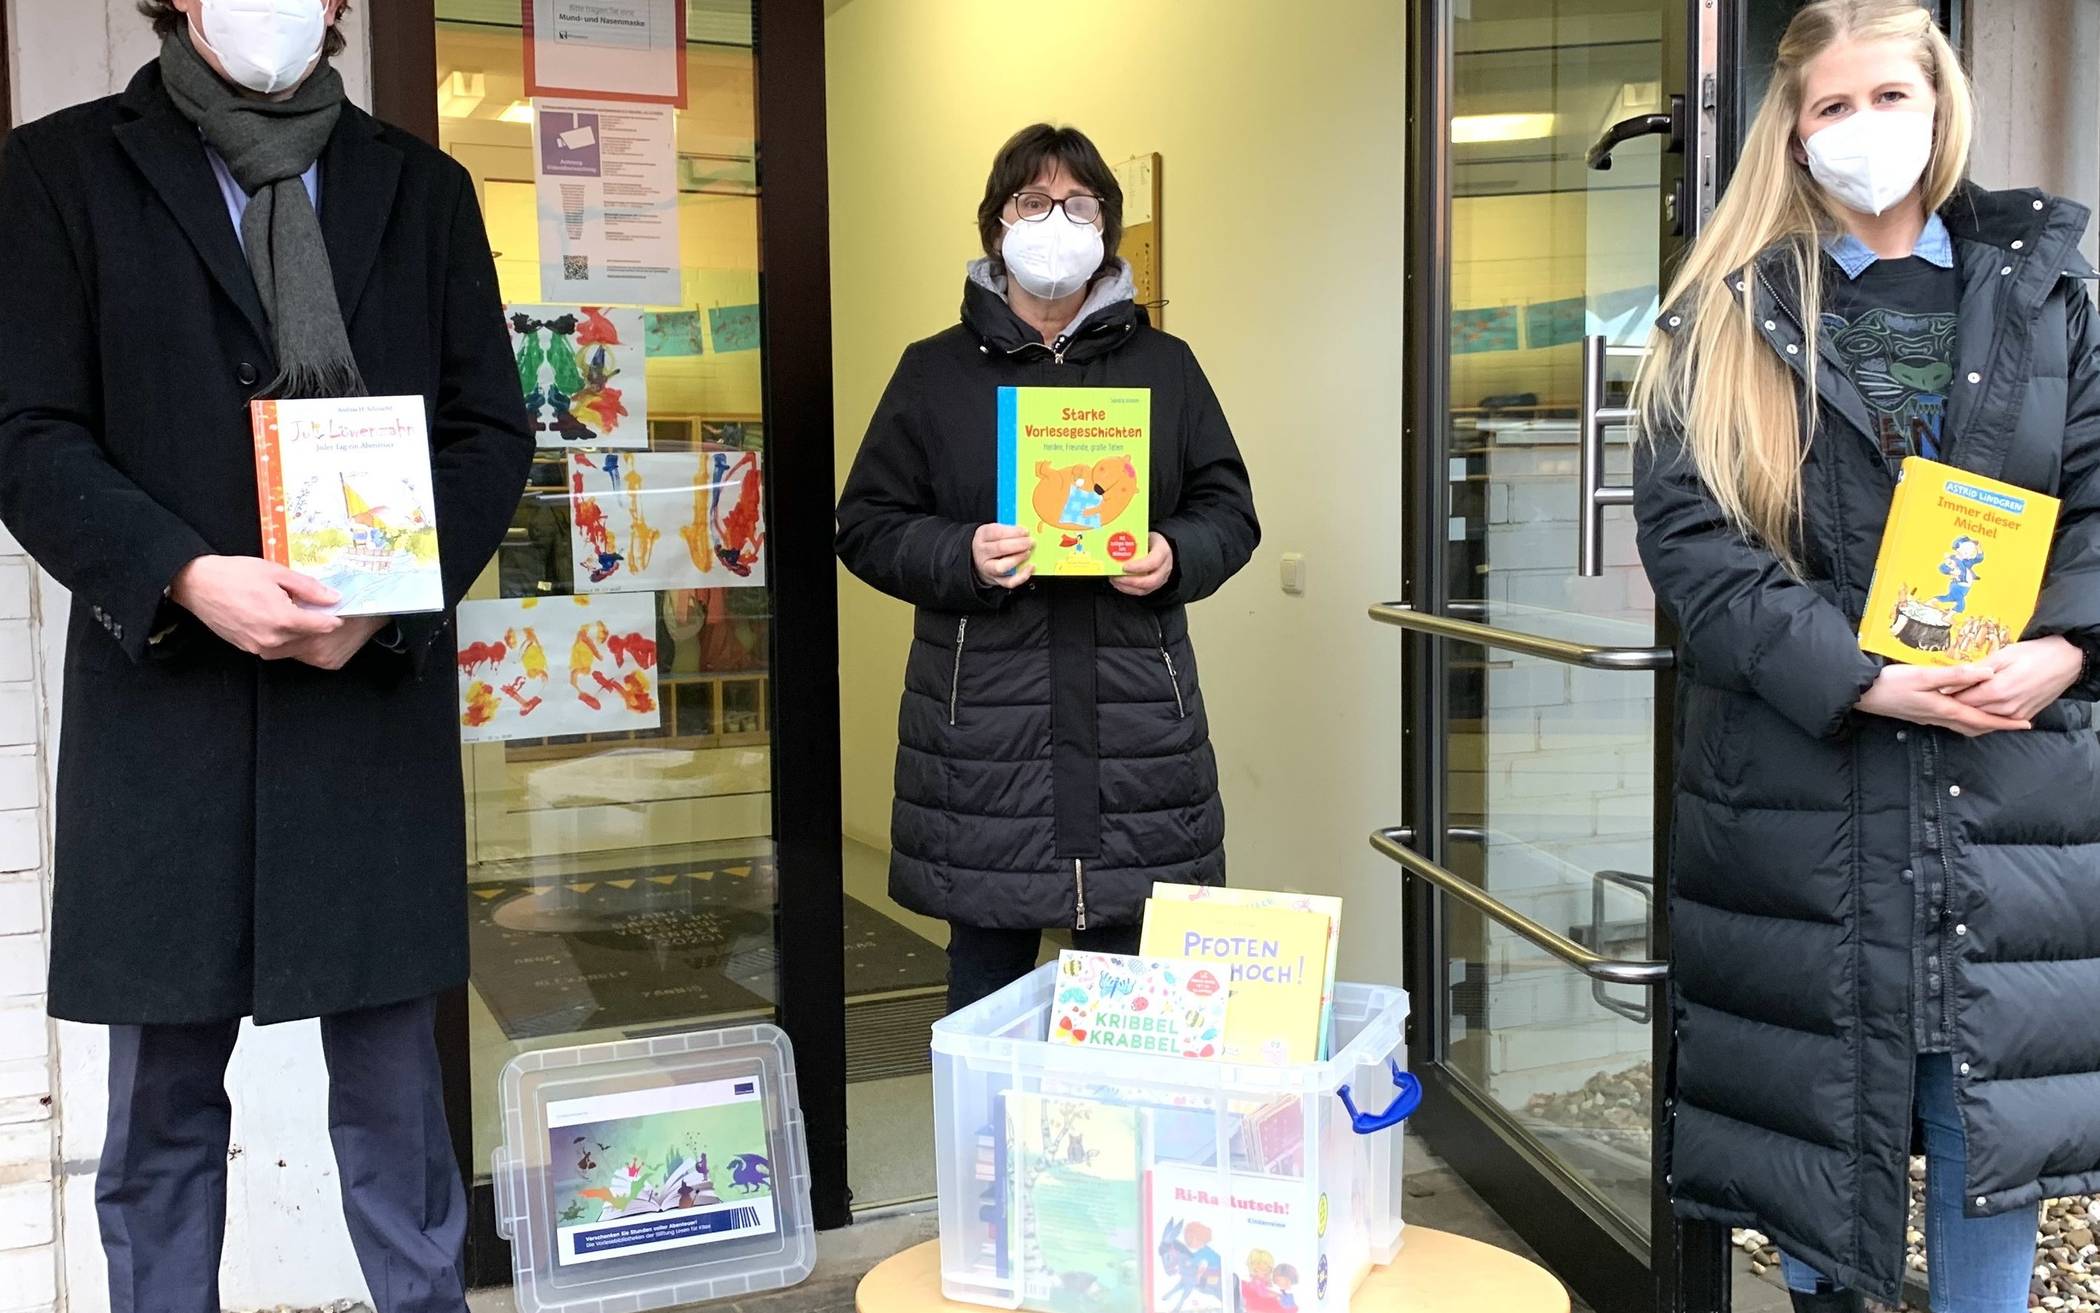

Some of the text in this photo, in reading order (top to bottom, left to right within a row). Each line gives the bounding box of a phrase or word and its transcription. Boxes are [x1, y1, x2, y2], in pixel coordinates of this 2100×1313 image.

[559, 13, 582, 22] Mund-
[600, 17, 645, 26] Nasenmaske
[1062, 408, 1106, 421] Starke
[1025, 425, 1142, 438] Vorlesegeschichten
[1937, 496, 2022, 530] Immer dieser
[1954, 516, 1998, 538] Michel
[1184, 931, 1278, 958] PFOTEN
[1096, 1012, 1178, 1034] KRIBBEL
[1090, 1030, 1180, 1053] KRABBEL
[585, 1232, 620, 1242] Verschenken
[630, 1227, 652, 1235] Stunden
[669, 1220, 698, 1228] Abenteuer!
[656, 1230, 674, 1238] Stiftung
